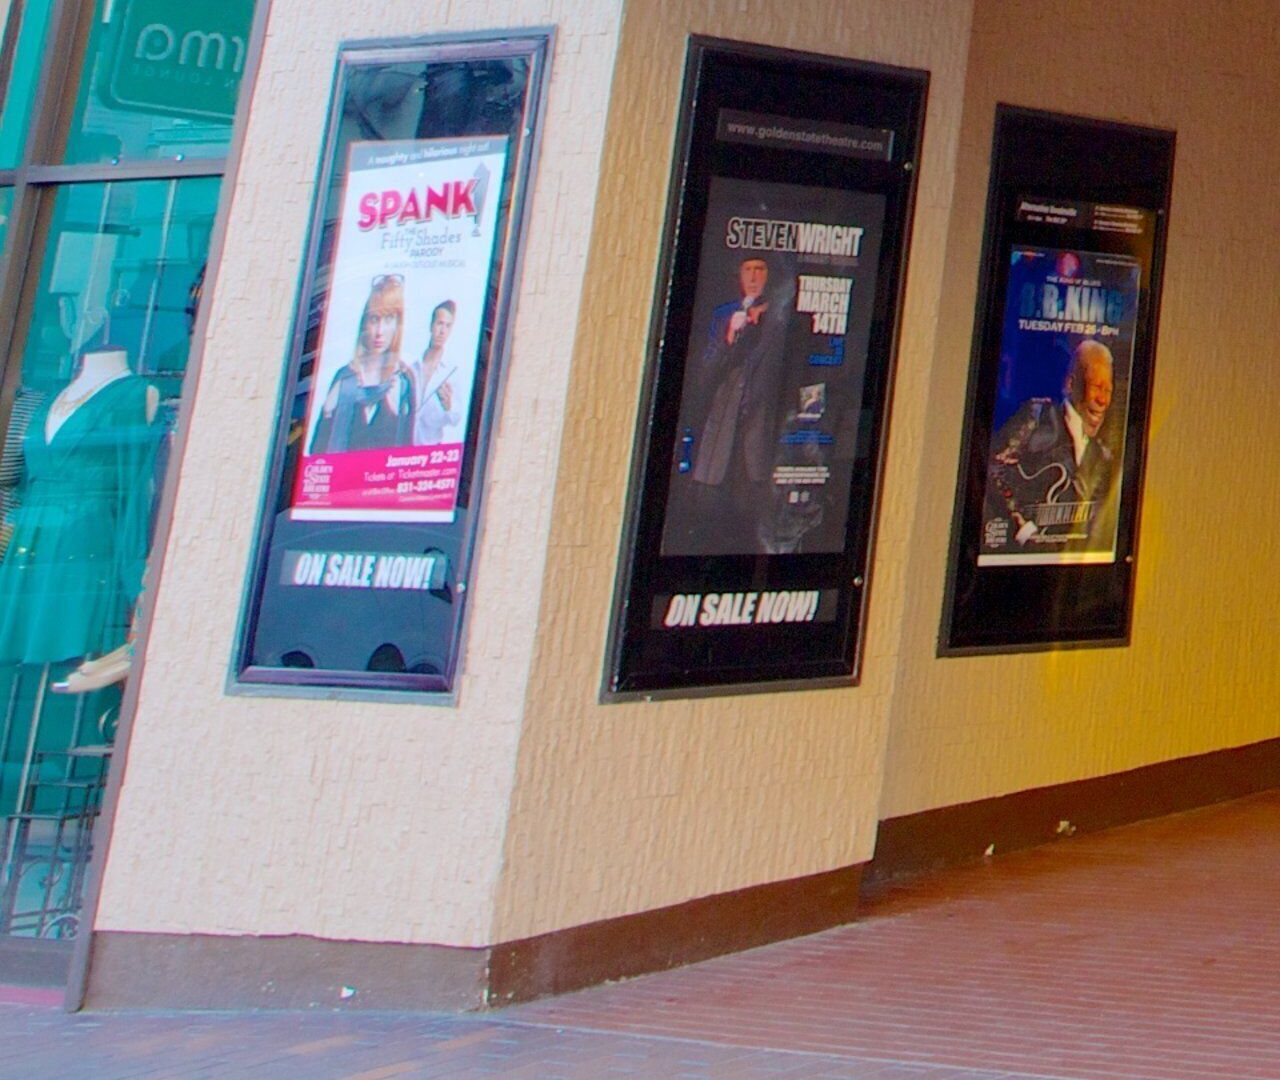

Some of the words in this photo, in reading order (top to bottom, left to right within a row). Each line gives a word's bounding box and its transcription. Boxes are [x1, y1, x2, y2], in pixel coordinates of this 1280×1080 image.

[415, 225, 462, 246] Shades
[798, 275, 854, 293] THURSDAY
[796, 291, 851, 313] MARCH
[811, 312, 848, 335] 14TH
[1018, 318, 1064, 332] TUESDAY
[385, 454, 428, 468] January
[293, 552, 327, 586] ON
[323, 553, 375, 588] SALE
[374, 555, 436, 590] NOW!
[664, 593, 700, 628] ON
[698, 591, 758, 626] SALE
[755, 590, 820, 624] NOW!
